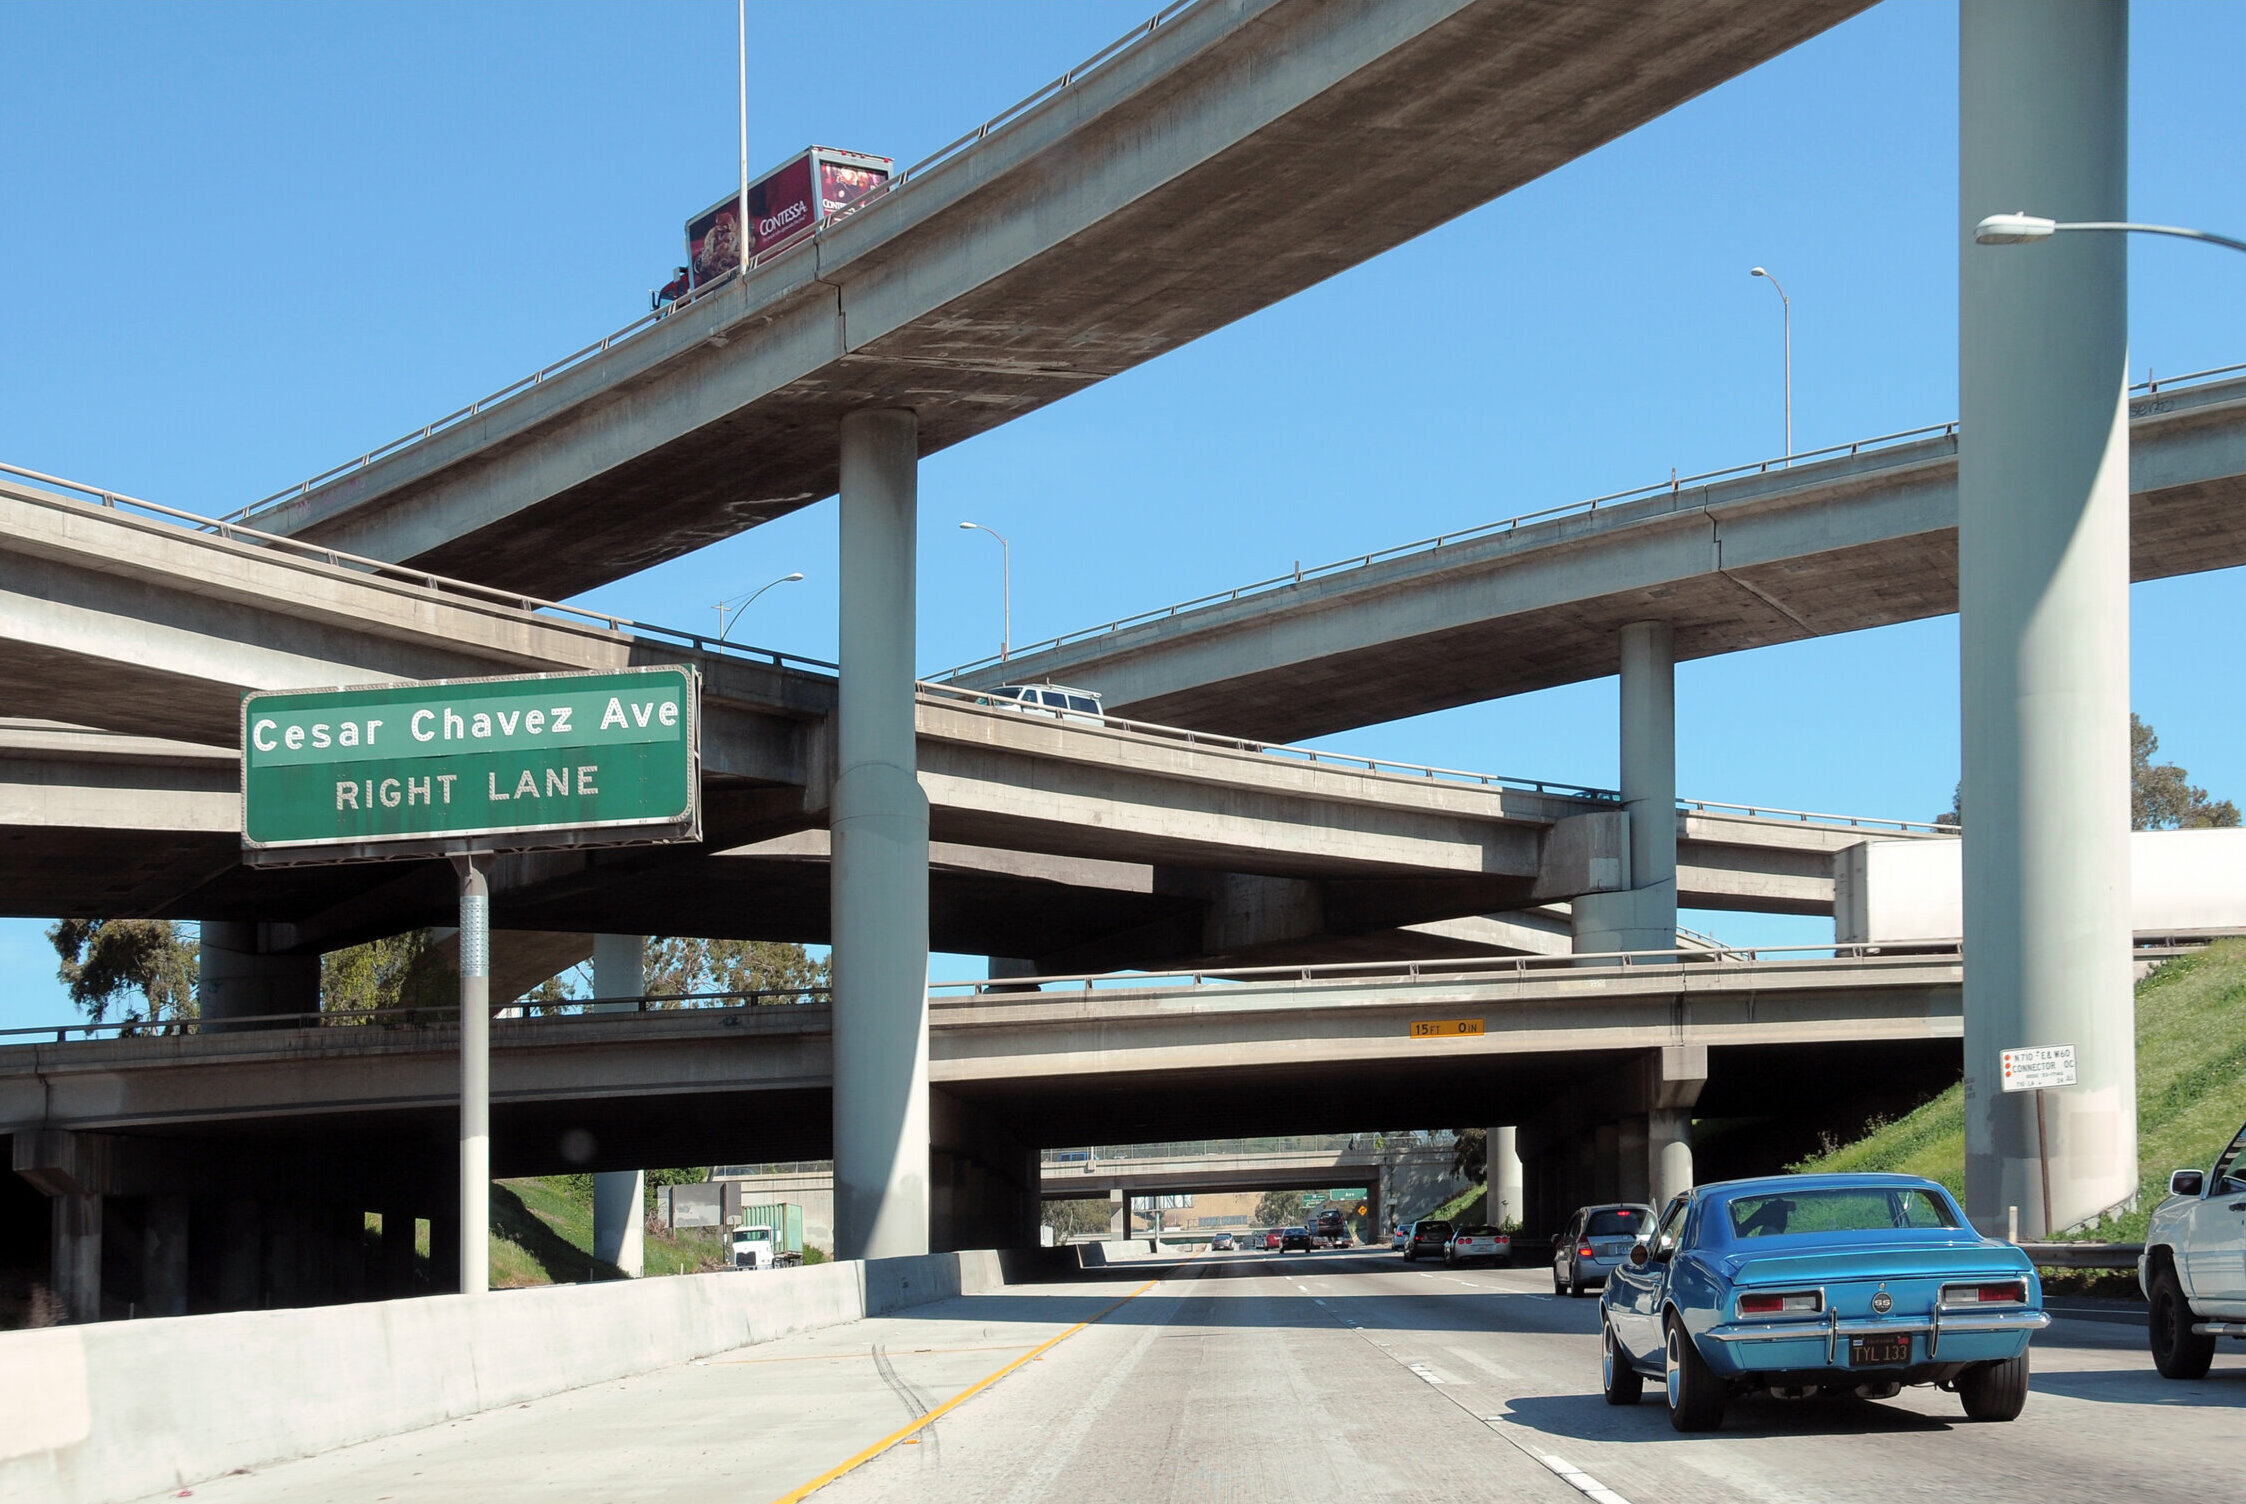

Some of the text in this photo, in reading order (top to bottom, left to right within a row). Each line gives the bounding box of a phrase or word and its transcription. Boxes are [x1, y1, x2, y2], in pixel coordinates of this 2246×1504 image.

[760, 200, 807, 236] CONTESSA
[253, 697, 679, 752] Cesar Chavez Ave
[336, 765, 599, 811] RIGHT LANE
[2013, 1061, 2057, 1073] CONNECTOR
[1853, 1344, 1909, 1362] TYL 133
